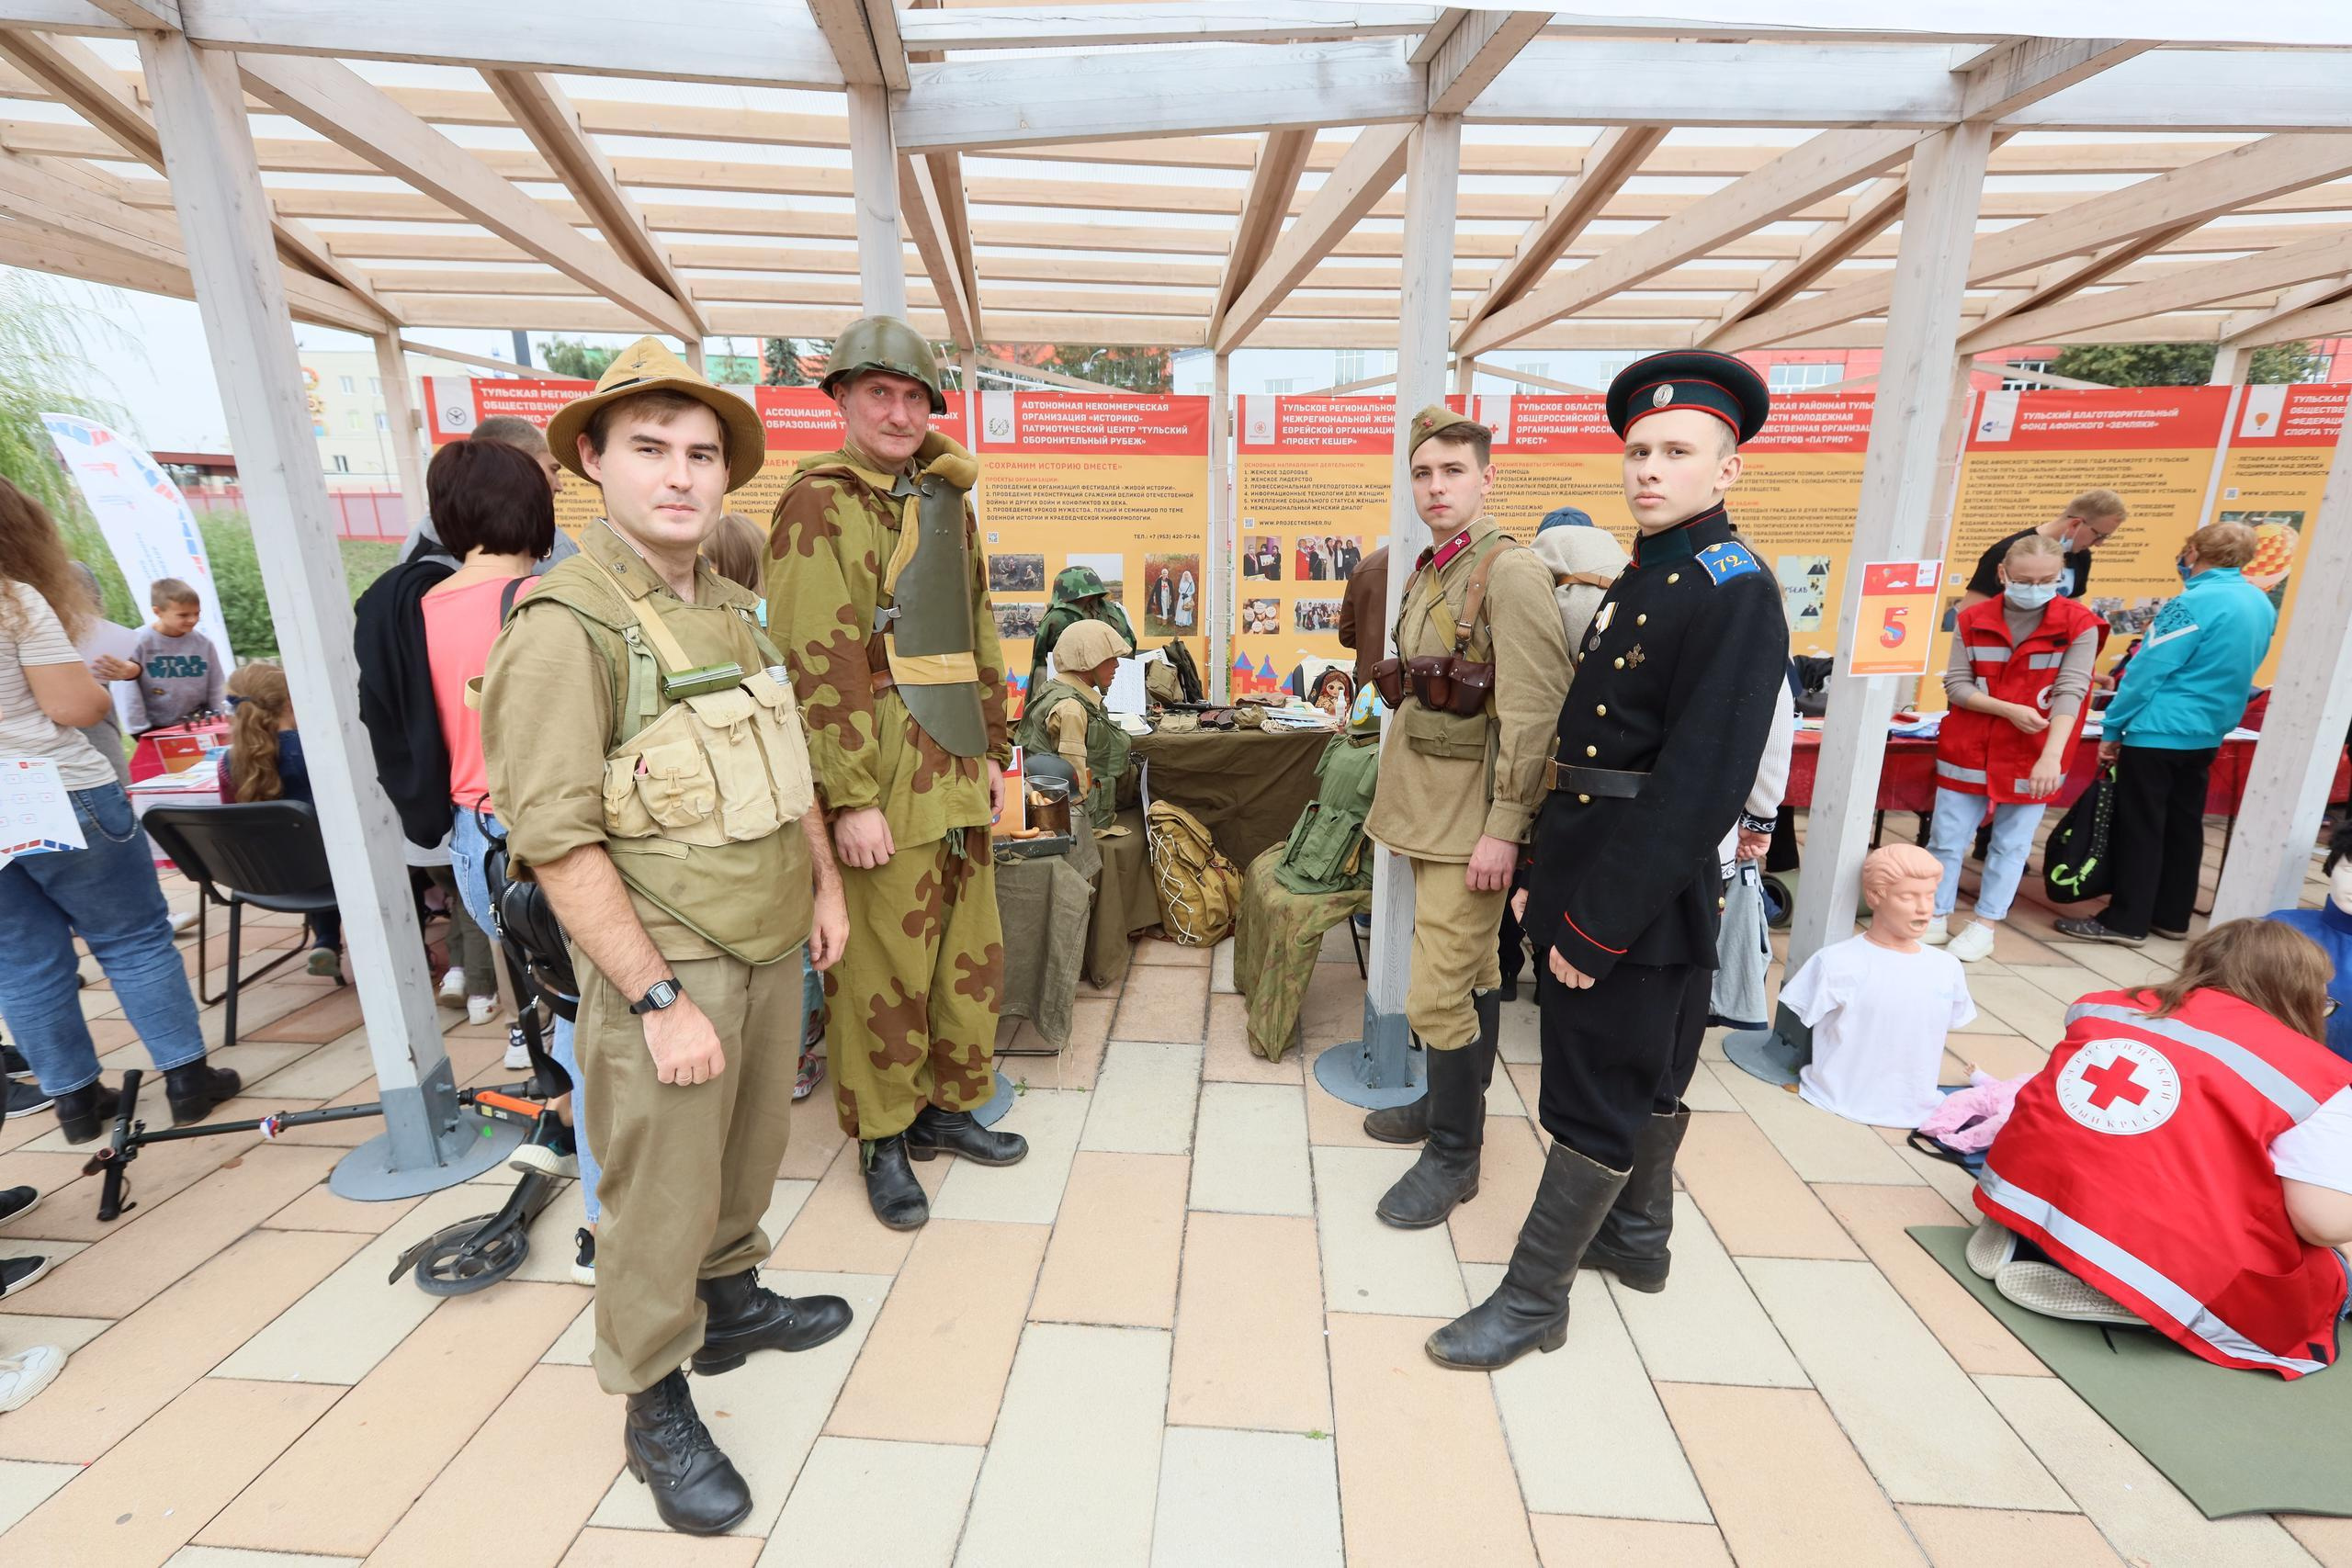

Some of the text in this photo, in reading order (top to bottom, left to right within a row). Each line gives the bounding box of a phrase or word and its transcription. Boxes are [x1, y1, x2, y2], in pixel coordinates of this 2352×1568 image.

[481, 388, 539, 398] ТУЛЬСКАЯ
[1022, 401, 1169, 412] АВТОНОМНАЯ НЕКОММЕРЧЕСКАЯ
[1283, 404, 1327, 412] ТУЛЬСКОЕ
[1799, 400, 1846, 410] РАЙОННАЯ
[765, 408, 831, 418] АССОЦИАЦИЯ
[1022, 413, 1143, 423] ОРГАНИЗАЦИЯ «ИСТОРИКО-
[1283, 413, 1371, 423] МЕЖРЕГИОНАЛЬНОЙ
[1517, 412, 1600, 423] ОБЩЕРОССИЙСКОЙ
[1791, 413, 1853, 422] МОЛОДЕЖНАЯ
[2022, 408, 2179, 420] ТУЛЬСКИЙ БЛАГОТВОРИТЕЛЬНЫЙ
[766, 418, 837, 429] ОБРАЗОВАНИЙ
[1023, 423, 1187, 434] ПАТРИОТИЧЕСКИЙ ЦЕНТР "ТУЛЬСКИЙ
[2019, 423, 2047, 431] ФОНД
[2049, 422, 2104, 431] АФОНСКОГО
[1283, 424, 1333, 434] ЕВРЕЙСКОЙ
[1023, 434, 1147, 446] ОБОРОНИТЕЛЬНЫЙ РУБЕЖ»
[1282, 437, 1357, 446] «ПРОЕКТ КЕШЕР»
[1805, 435, 1852, 444] «ПАТРИОТ»
[1038, 462, 1081, 470] ИСТОРИЮ
[1880, 607, 1908, 649] 5
